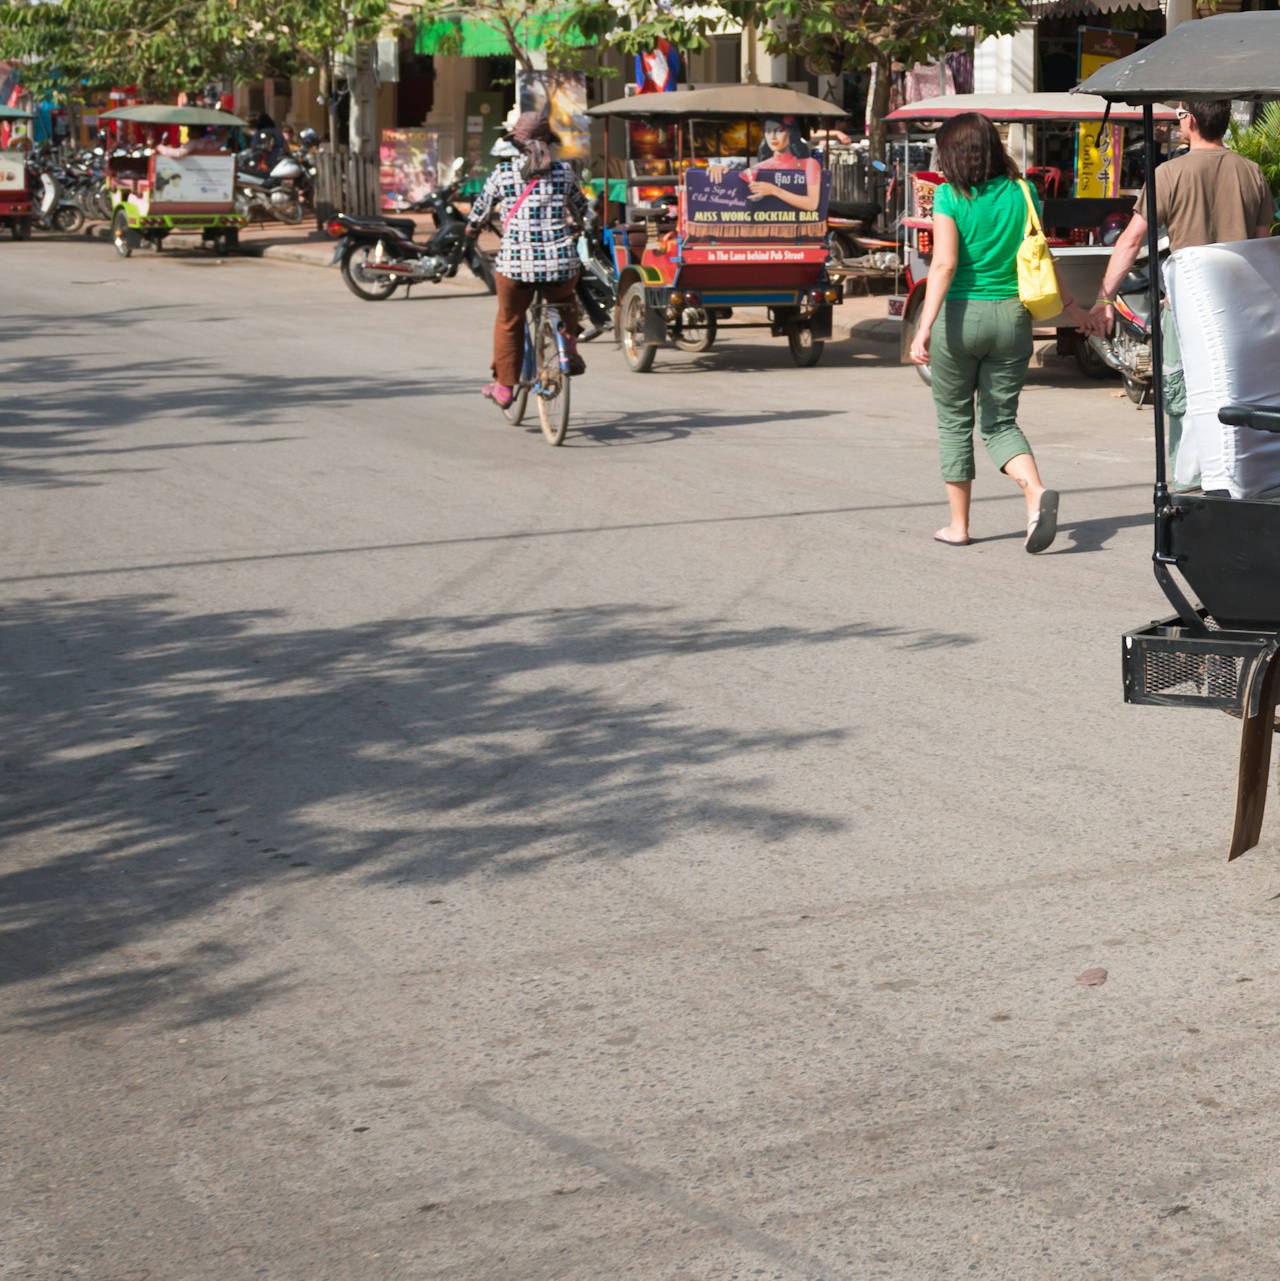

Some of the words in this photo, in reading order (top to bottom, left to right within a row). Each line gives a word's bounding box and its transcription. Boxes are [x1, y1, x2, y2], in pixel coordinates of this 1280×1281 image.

[1081, 134, 1095, 192] Cookies
[709, 194, 747, 207] Shanghai
[693, 211, 718, 222] MISS
[720, 211, 751, 222] WONG
[753, 211, 797, 222] COCKTAIL
[798, 211, 820, 222] BAR
[707, 252, 715, 261] in
[716, 251, 729, 261] The
[730, 251, 746, 261] Lane
[746, 250, 769, 261] behind
[769, 250, 783, 261] Pub
[784, 250, 805, 260] Street
